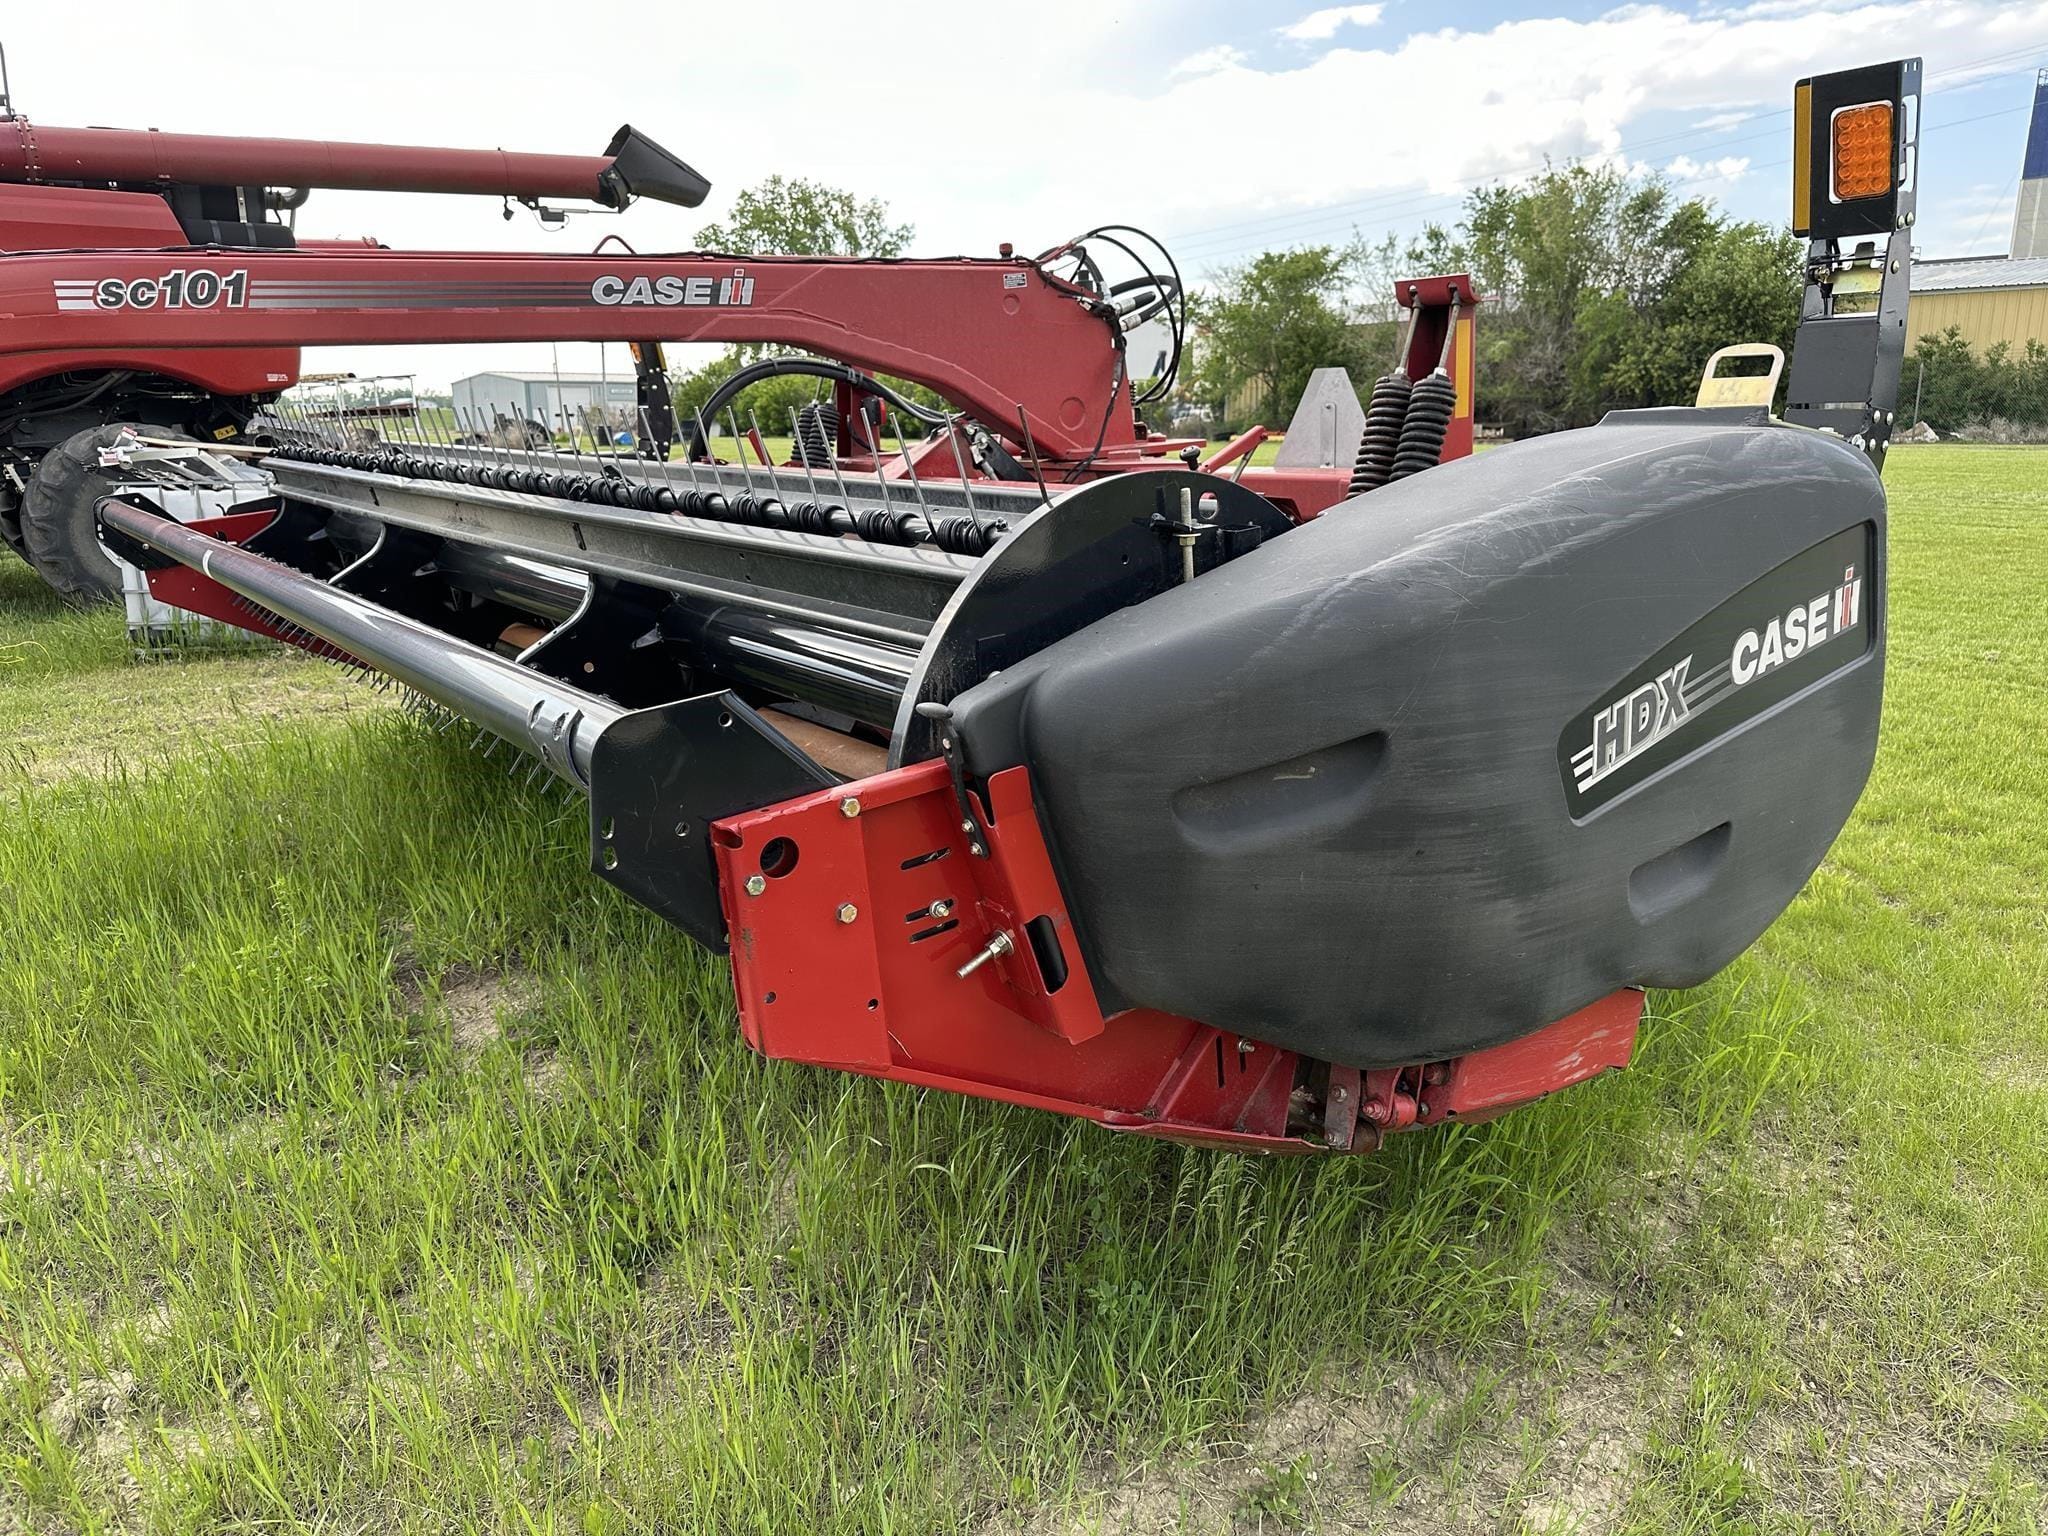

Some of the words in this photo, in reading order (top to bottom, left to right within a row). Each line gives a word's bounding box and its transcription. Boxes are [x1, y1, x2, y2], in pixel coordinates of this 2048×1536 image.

[591, 275, 714, 305] CASE
[1591, 653, 1693, 780] HDX
[1731, 594, 1830, 686] CASE
